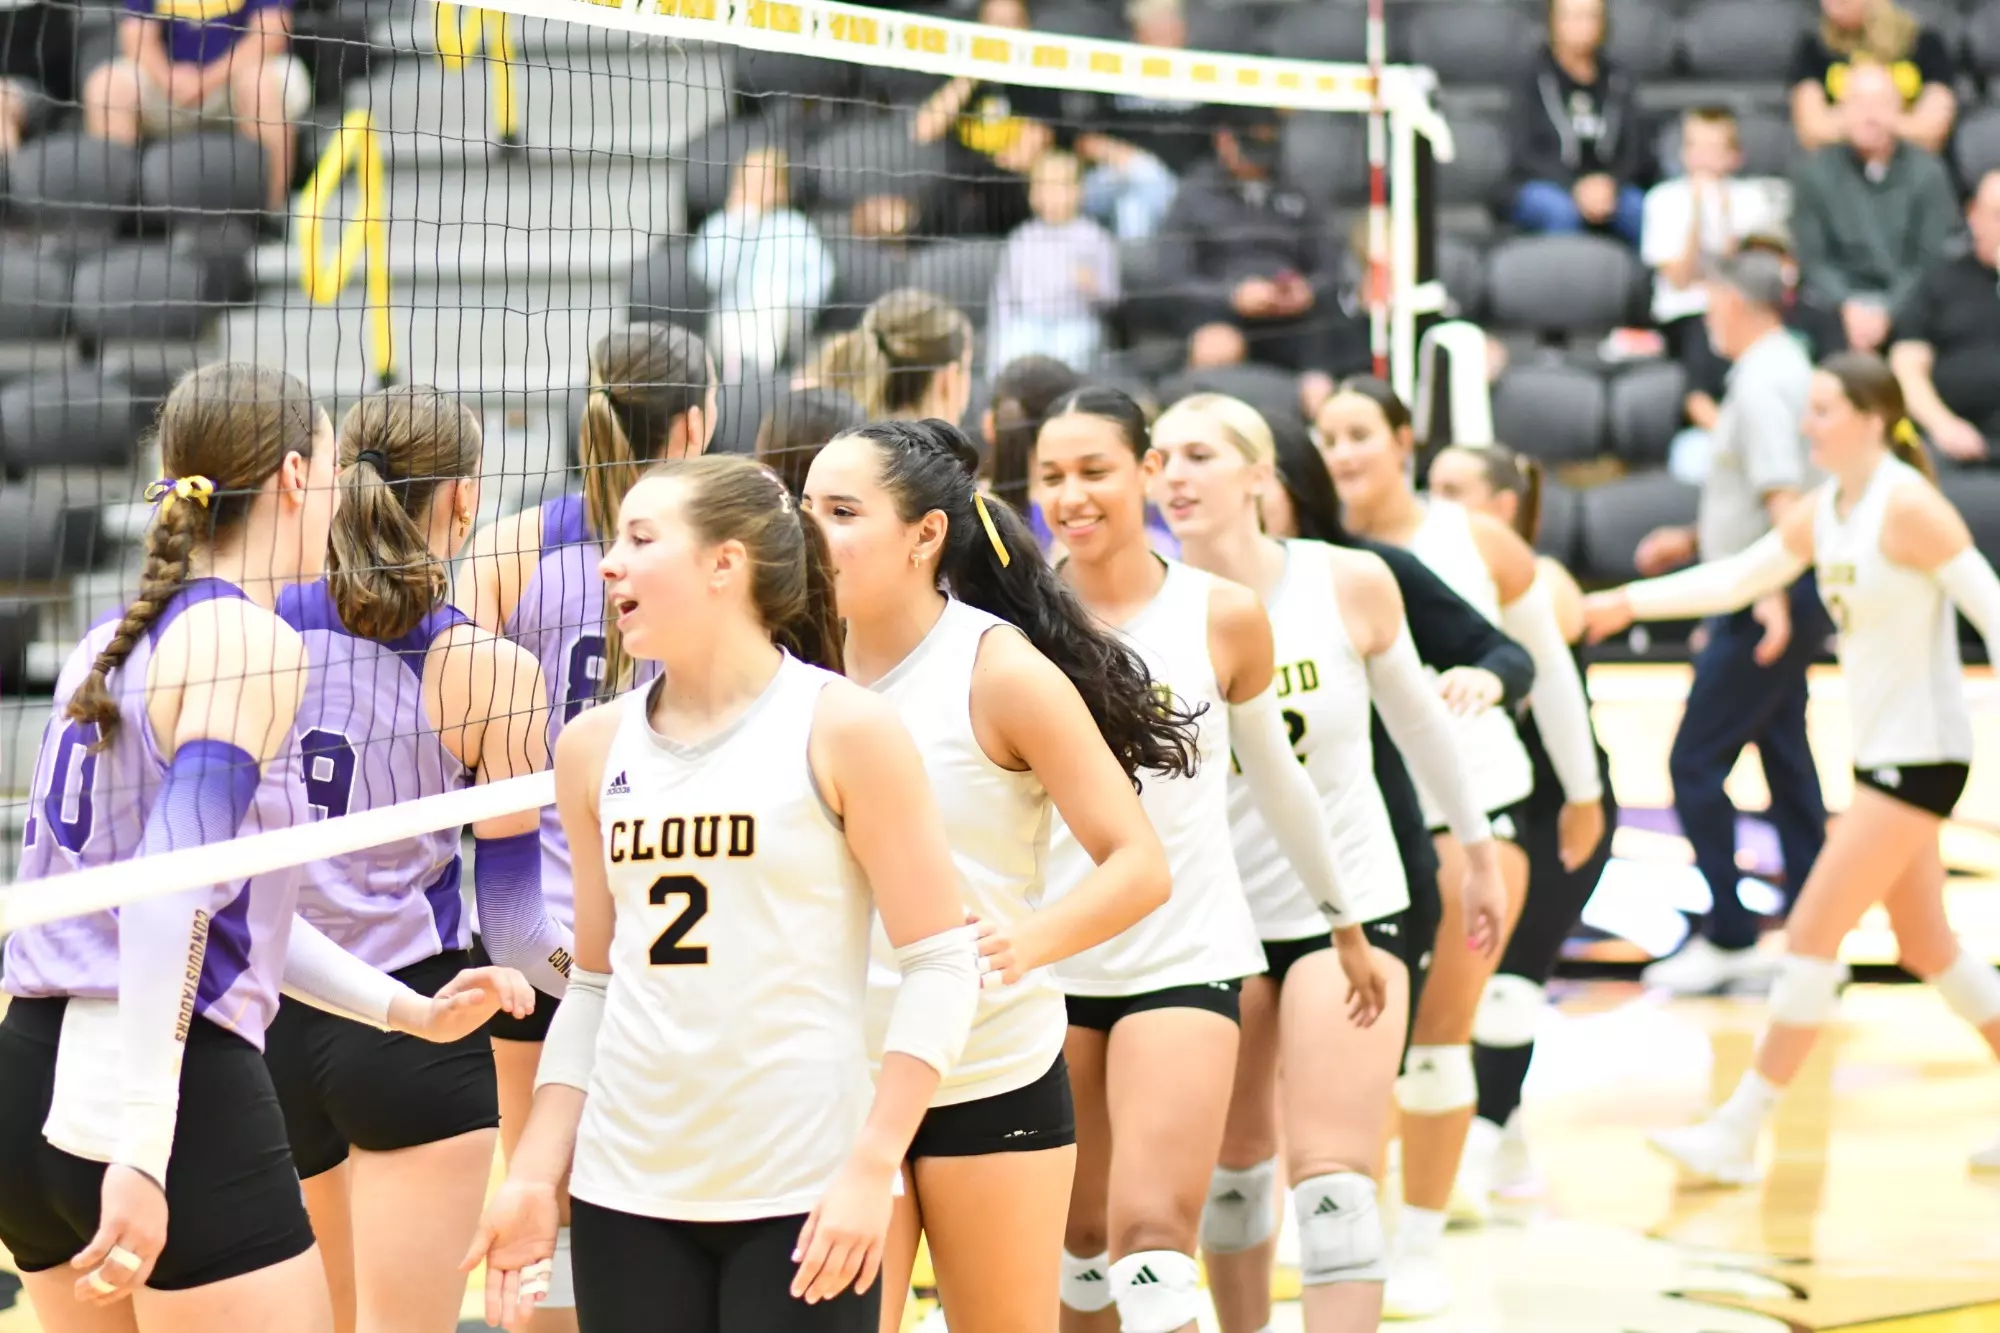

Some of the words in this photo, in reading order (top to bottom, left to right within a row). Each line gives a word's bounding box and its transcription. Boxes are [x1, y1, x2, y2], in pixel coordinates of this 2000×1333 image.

[1276, 661, 1318, 697] UD
[610, 814, 754, 863] CLOUD
[649, 875, 708, 965] 2
[175, 909, 209, 1042] CONQUISTADORS
[548, 947, 574, 978] CON
